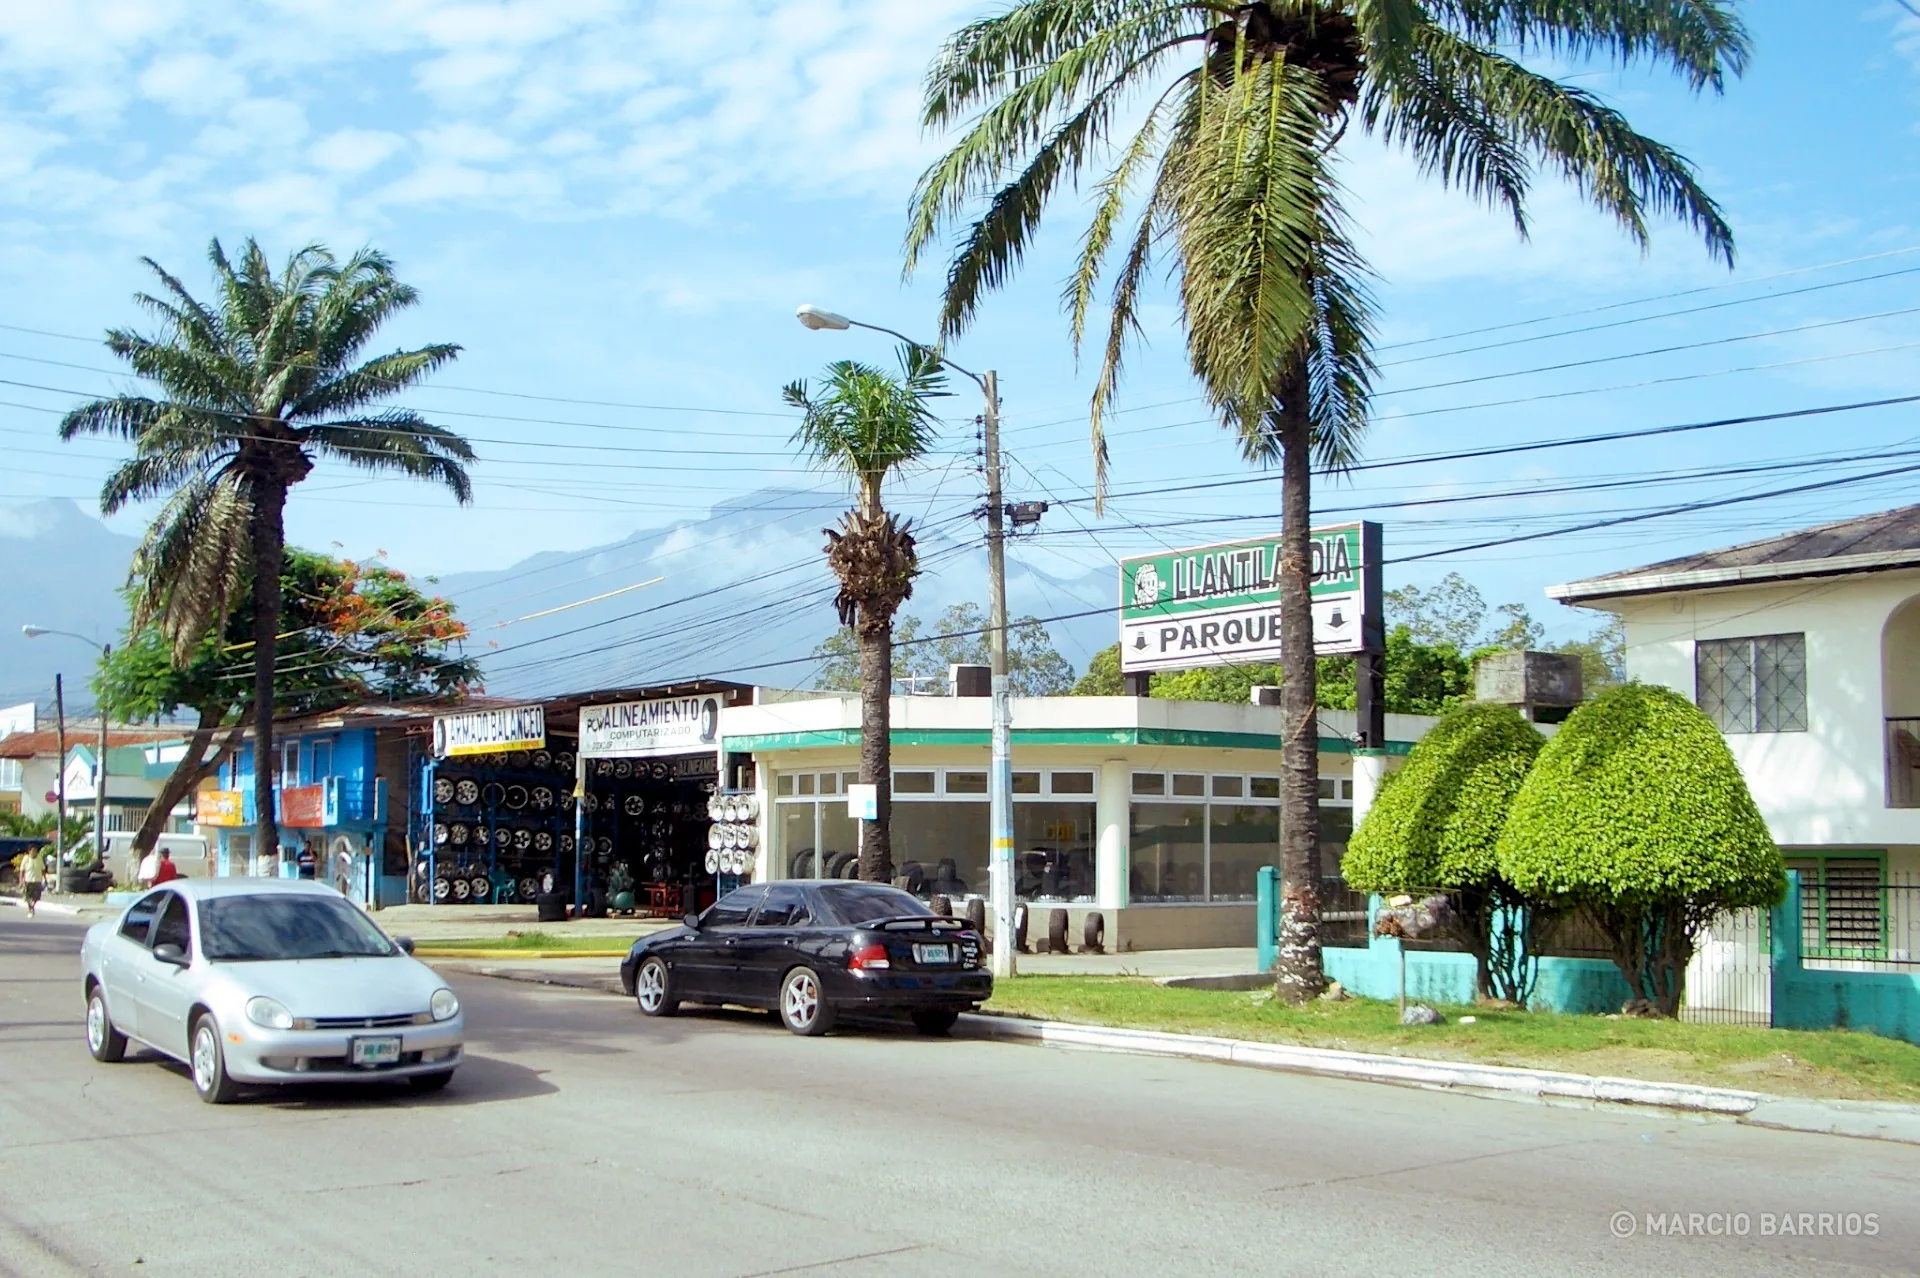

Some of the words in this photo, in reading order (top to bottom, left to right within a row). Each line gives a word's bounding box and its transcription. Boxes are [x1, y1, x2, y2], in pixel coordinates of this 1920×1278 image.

[1173, 534, 1353, 604] LLANTILADIA
[450, 713, 488, 745] ARMADO
[491, 707, 542, 742] BALANCEO
[603, 698, 699, 729] ALINEAMIENTO
[610, 726, 691, 740] COMPUTARIZADO
